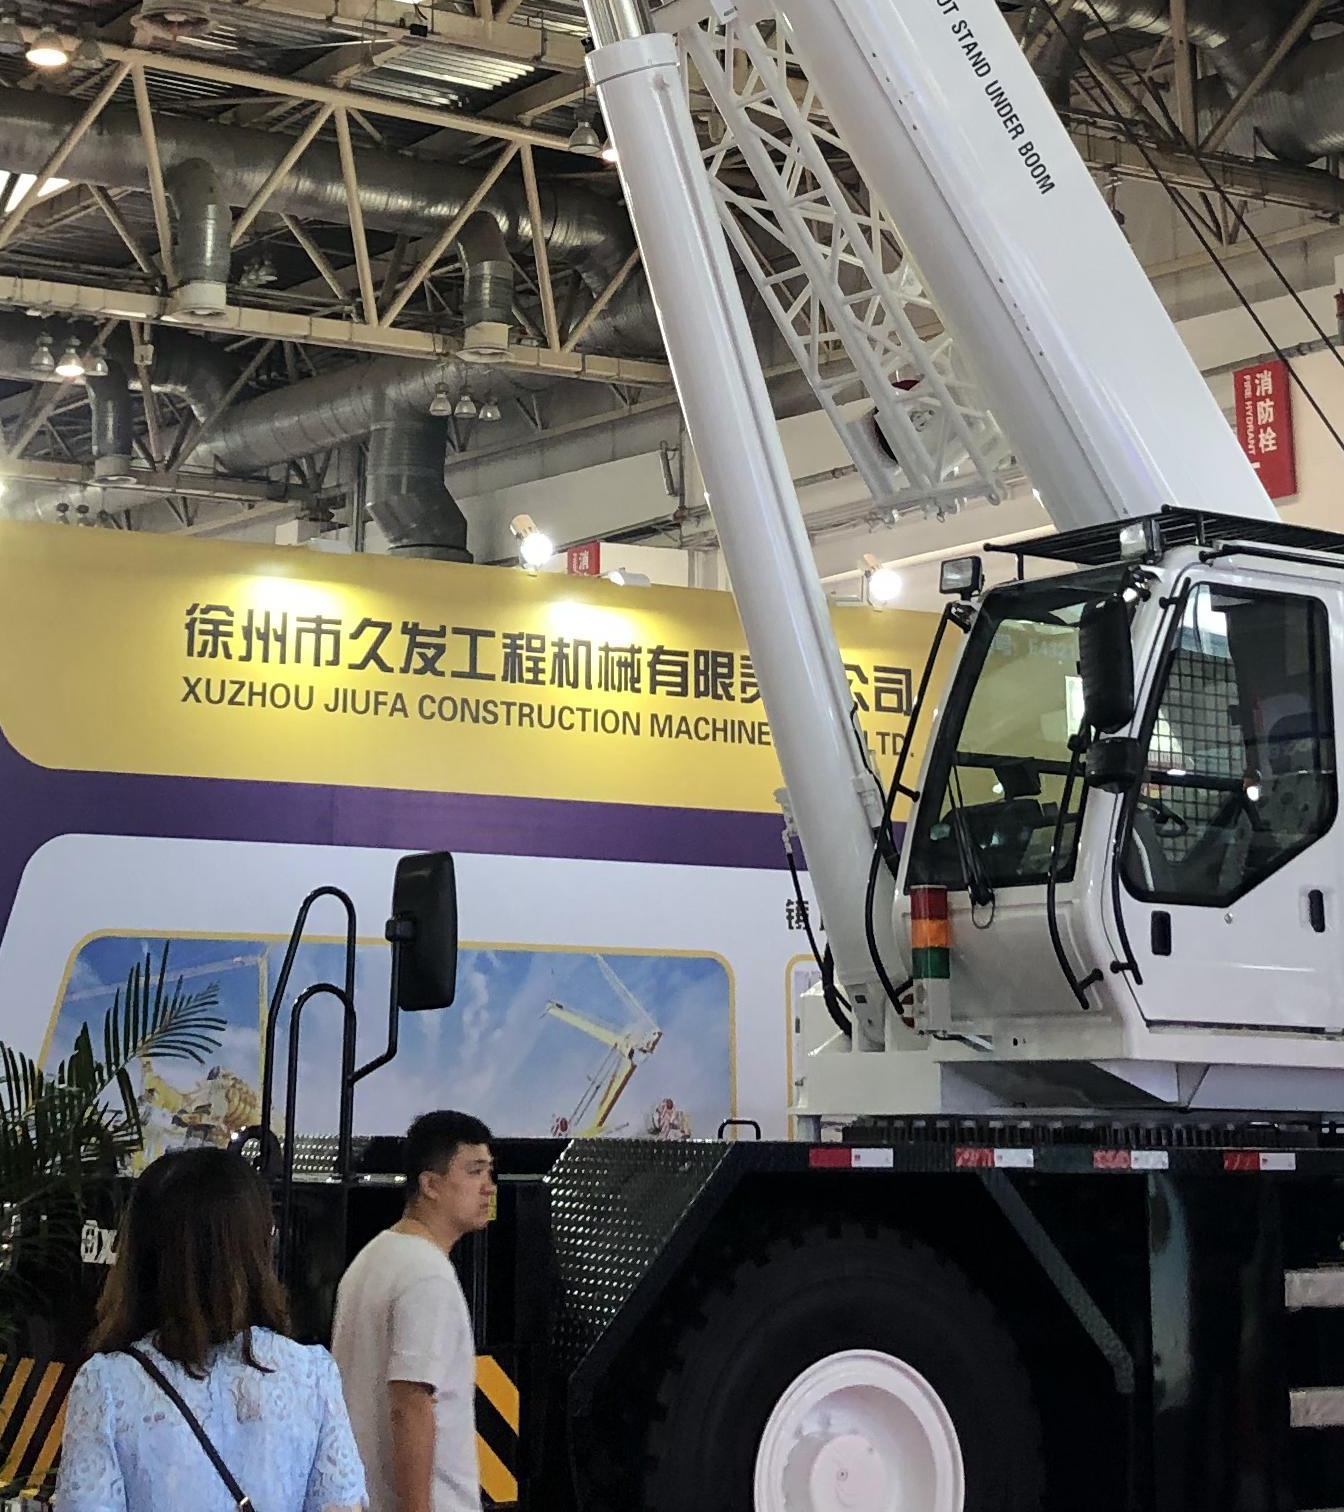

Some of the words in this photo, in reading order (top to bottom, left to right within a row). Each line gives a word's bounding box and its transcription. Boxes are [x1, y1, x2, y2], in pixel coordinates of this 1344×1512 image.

[951, 19, 992, 78] STAND
[984, 79, 1025, 141] UNDER
[1018, 141, 1055, 195] BOOM
[1243, 374, 1253, 399] FIRE
[1255, 370, 1277, 453] 消防栓
[1244, 400, 1257, 455] HYDRANT
[185, 602, 913, 717] 徐州市久发工程机械有限公司
[181, 676, 315, 710] XUZHOU
[323, 687, 409, 719] JIUFA
[418, 694, 641, 737] CONSTRUCTION
[650, 713, 773, 746] MACHINE
